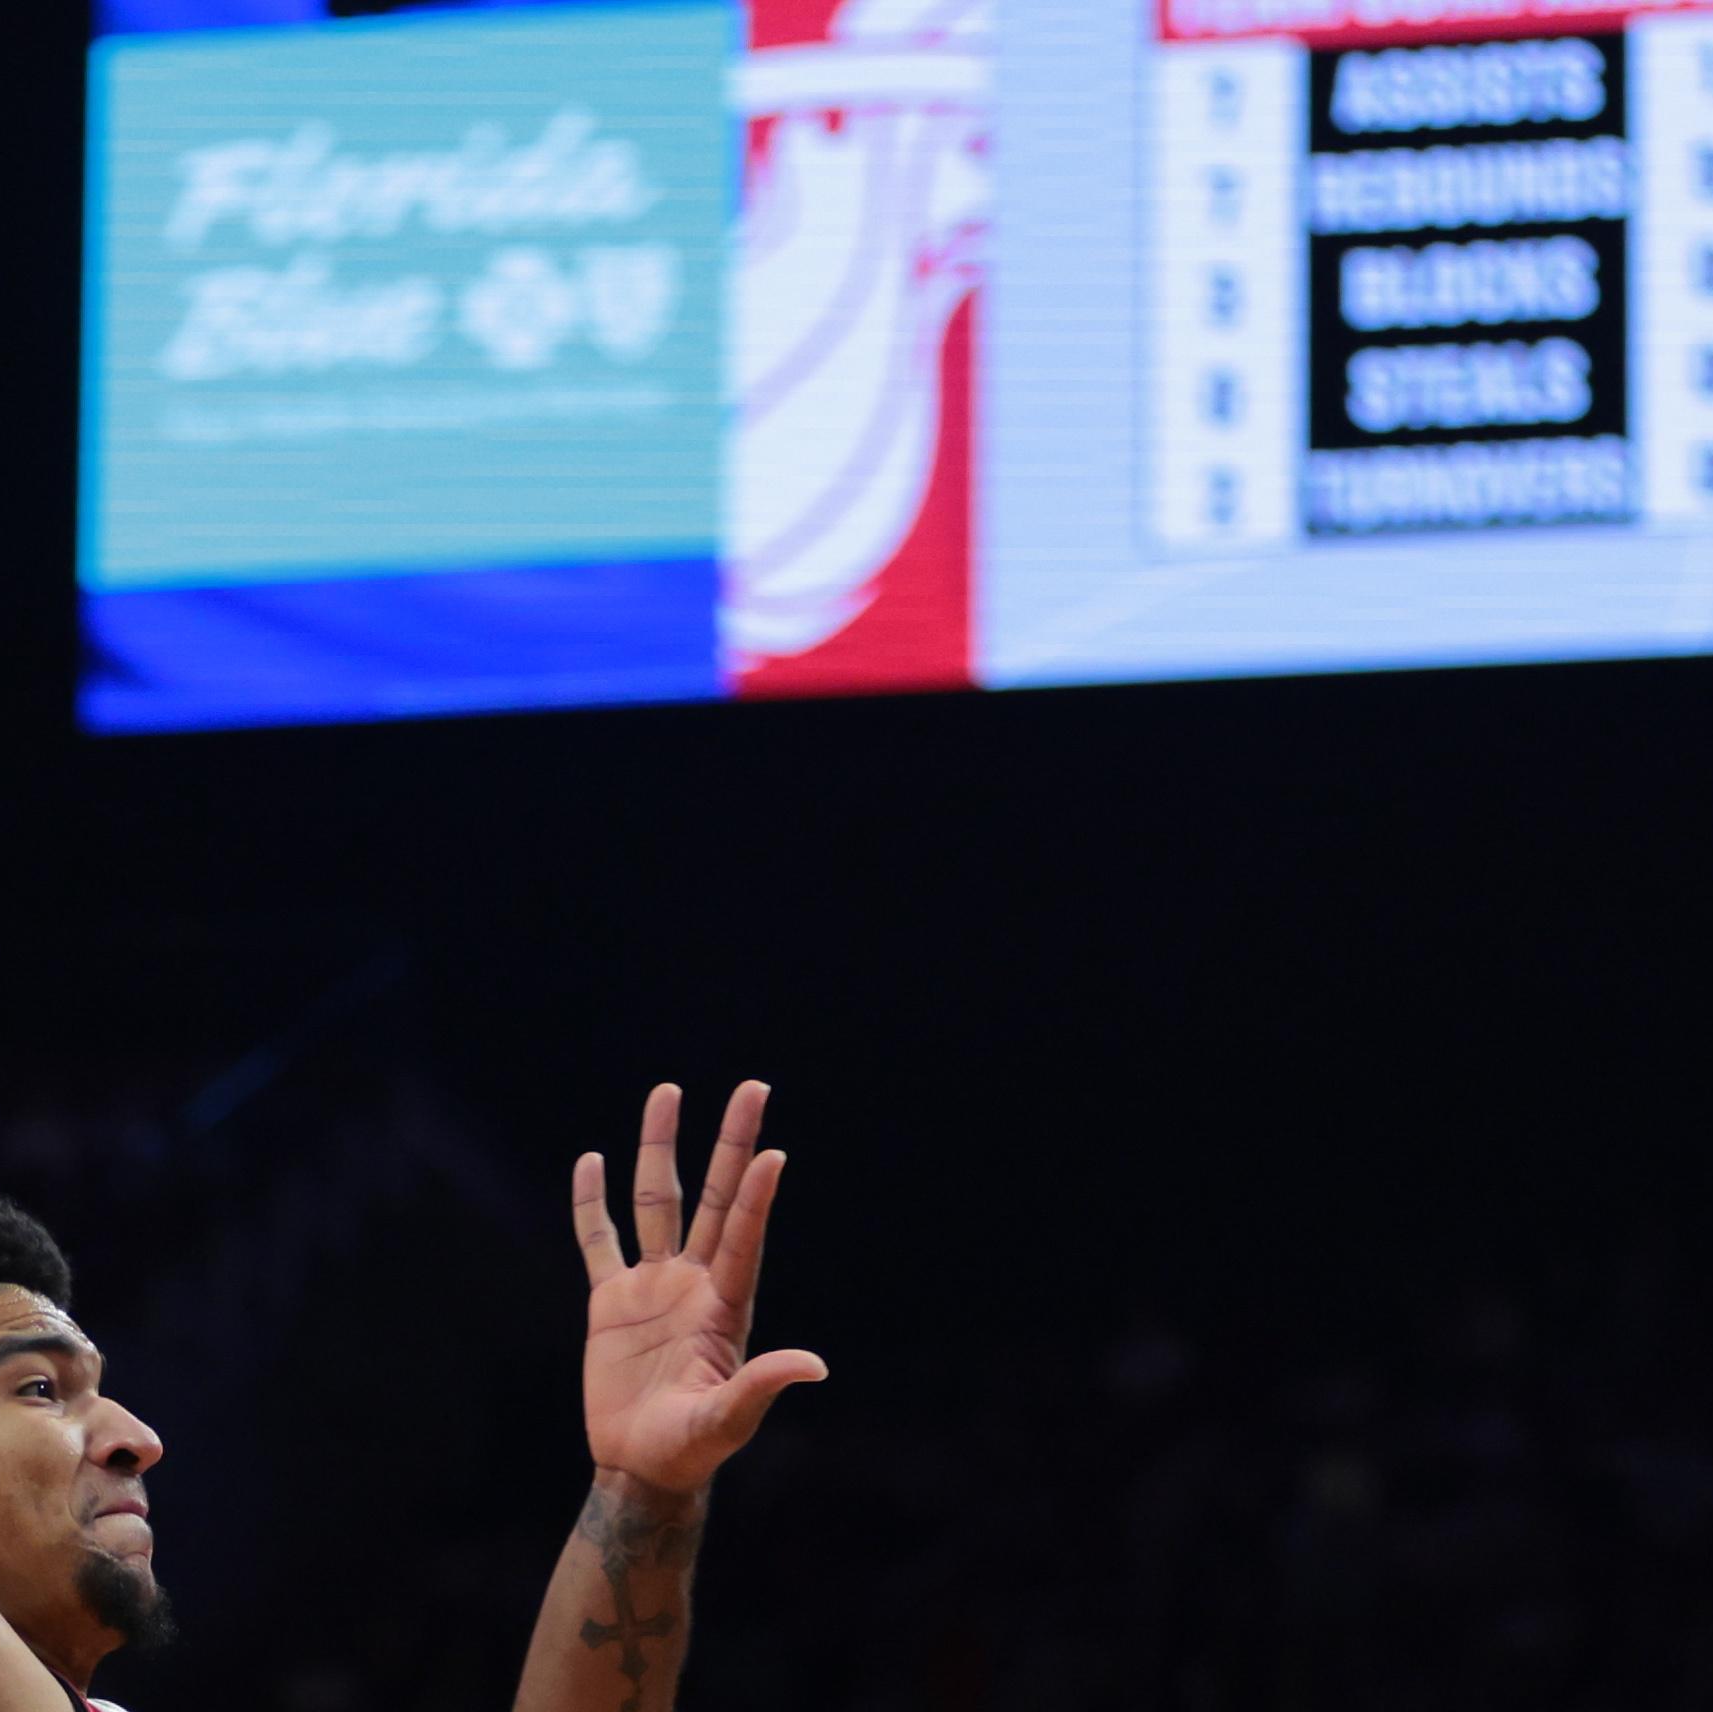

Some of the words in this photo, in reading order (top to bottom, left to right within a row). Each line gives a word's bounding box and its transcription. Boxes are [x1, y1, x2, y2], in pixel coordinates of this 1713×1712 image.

[1332, 37, 1606, 134] ASSISTS
[164, 104, 662, 250] Florida
[1309, 136, 1629, 234] REBOUNDS
[158, 254, 442, 378] Blue
[1340, 235, 1601, 331] BLOCKS
[1345, 336, 1592, 433] STEALS
